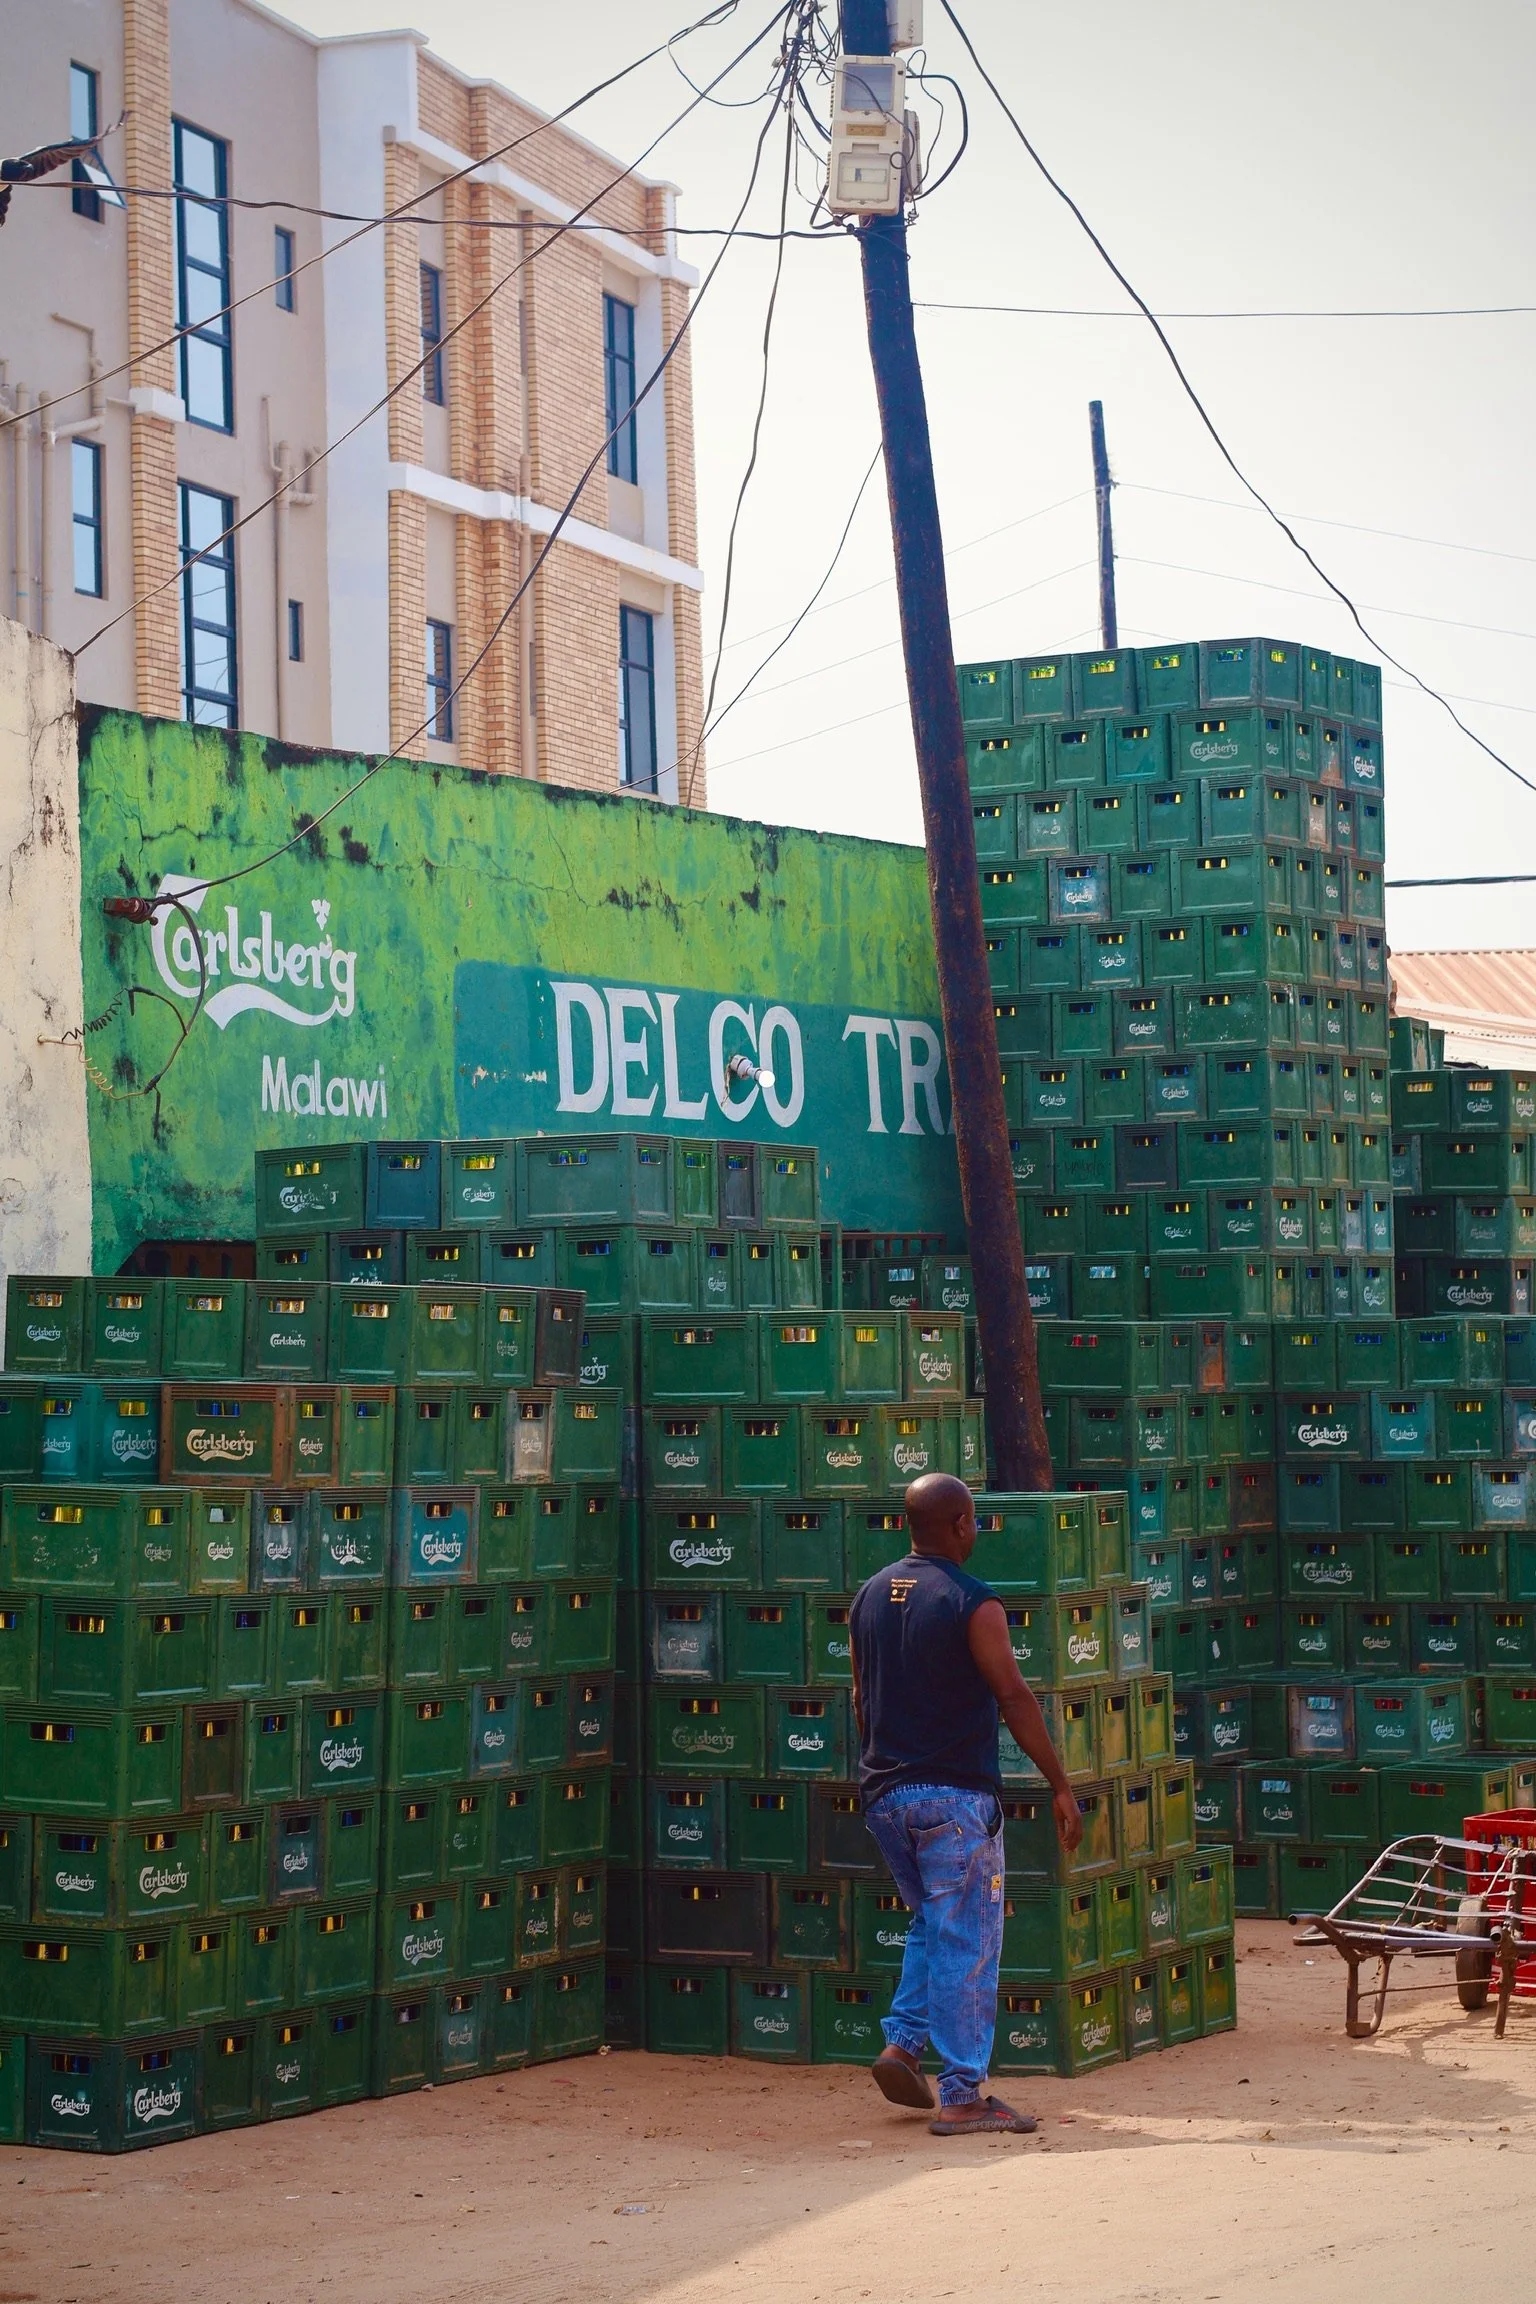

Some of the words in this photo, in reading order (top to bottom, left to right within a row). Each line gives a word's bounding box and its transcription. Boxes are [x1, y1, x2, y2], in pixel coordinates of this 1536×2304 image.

[1190, 740, 1239, 762] Carlsberg
[151, 873, 358, 1031] Carlsberg
[549, 981, 805, 1128] DELCO
[841, 1014, 955, 1137] TR
[261, 1055, 388, 1118] Malawi
[1446, 1285, 1493, 1306] Carlsberg
[26, 1325, 61, 1342] Carlsberg
[105, 1325, 141, 1342] Carlsberg
[270, 1333, 306, 1348] Carlsberg
[112, 1430, 157, 1462] Carlsberg
[187, 1429, 254, 1461] Carlsberg
[1297, 1424, 1348, 1447] Carlsberg
[665, 1452, 699, 1467] Carlsberg
[826, 1451, 862, 1468] Carlsberg
[894, 1444, 928, 1473] Carlsberg
[421, 1533, 462, 1563] Carlsberg
[669, 1539, 734, 1568] Carlsberg
[1068, 1634, 1100, 1664] Carlsberg
[672, 1726, 737, 1754] Carlsberg
[788, 1734, 824, 1751] Carlsberg
[320, 1739, 364, 1772] Carlsberg
[668, 1824, 703, 1841] Carlsberg
[56, 1871, 97, 1891] Carlsberg
[140, 1863, 190, 1898] Carlsberg
[402, 1930, 443, 1965] Carlsberg
[876, 1930, 908, 1946] Carlsber
[754, 2015, 789, 2034] Carlsberg
[51, 2094, 90, 2115] Carlsberg
[134, 2084, 182, 2122] Carlsberg
